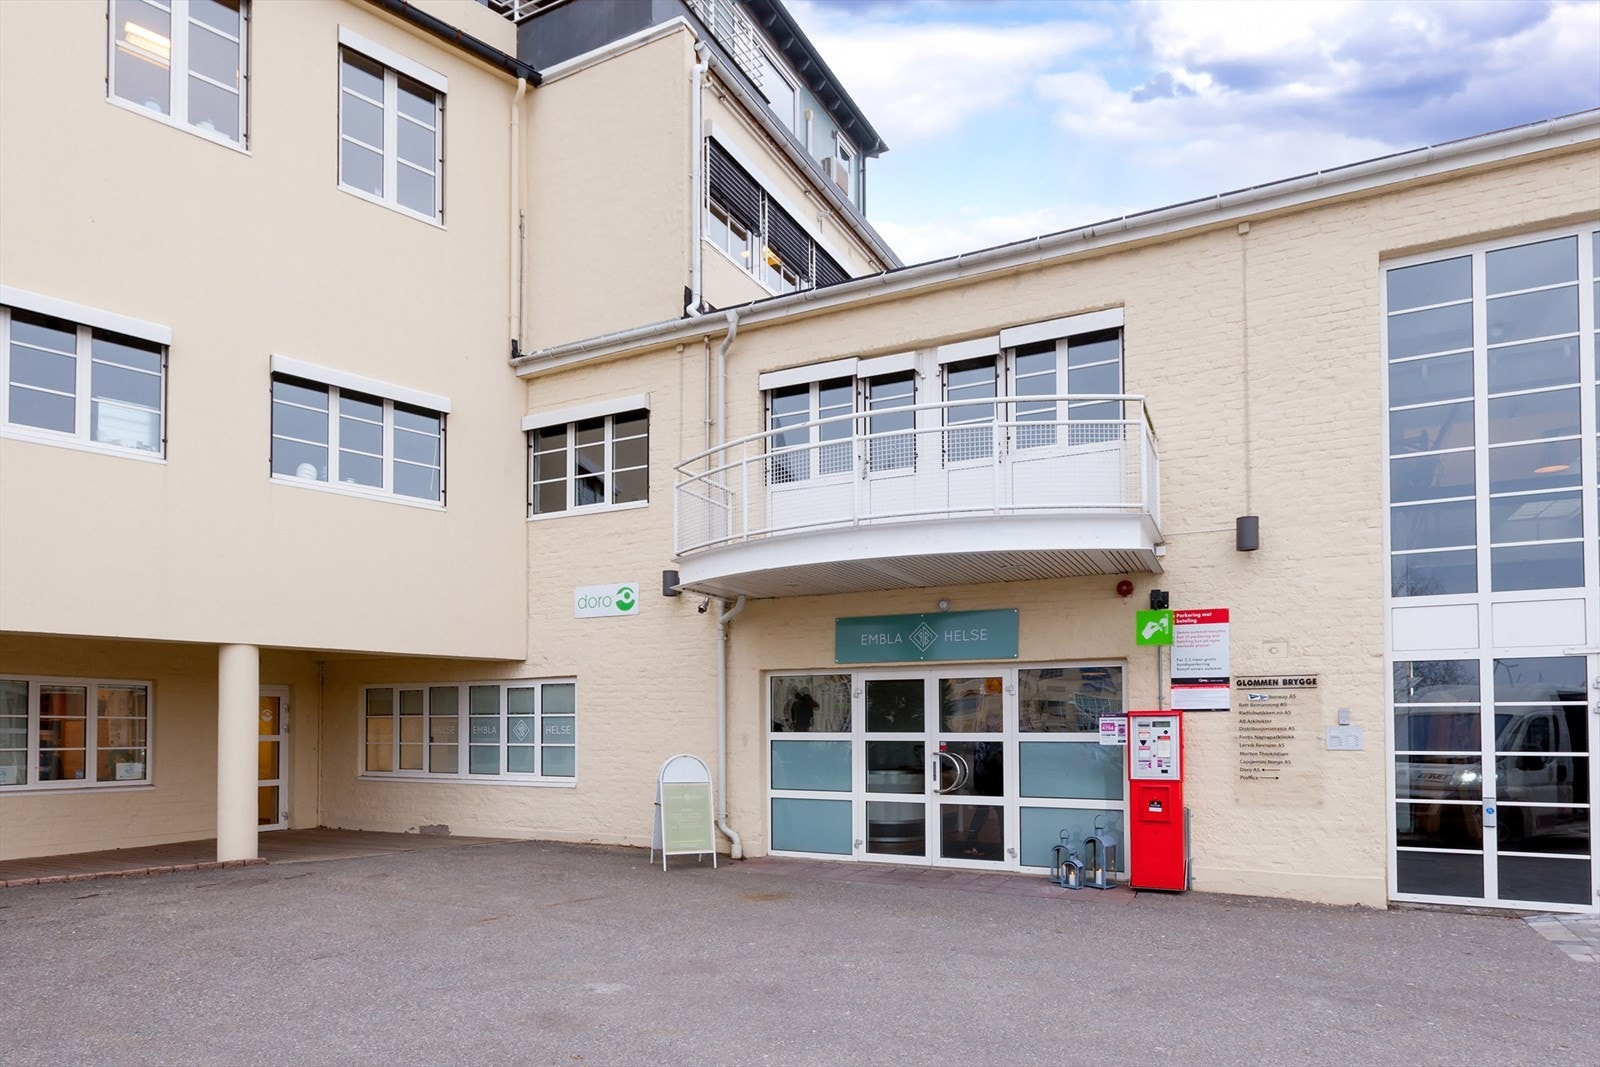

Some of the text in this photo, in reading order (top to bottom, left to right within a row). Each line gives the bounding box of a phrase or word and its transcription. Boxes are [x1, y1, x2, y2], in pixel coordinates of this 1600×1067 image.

[577, 594, 612, 609] doro
[861, 629, 988, 646] EMBLA HELSE
[1282, 678, 1317, 686] BRYGGE
[434, 726, 456, 735] HELSE
[473, 725, 571, 735] EMBLA HELSE
